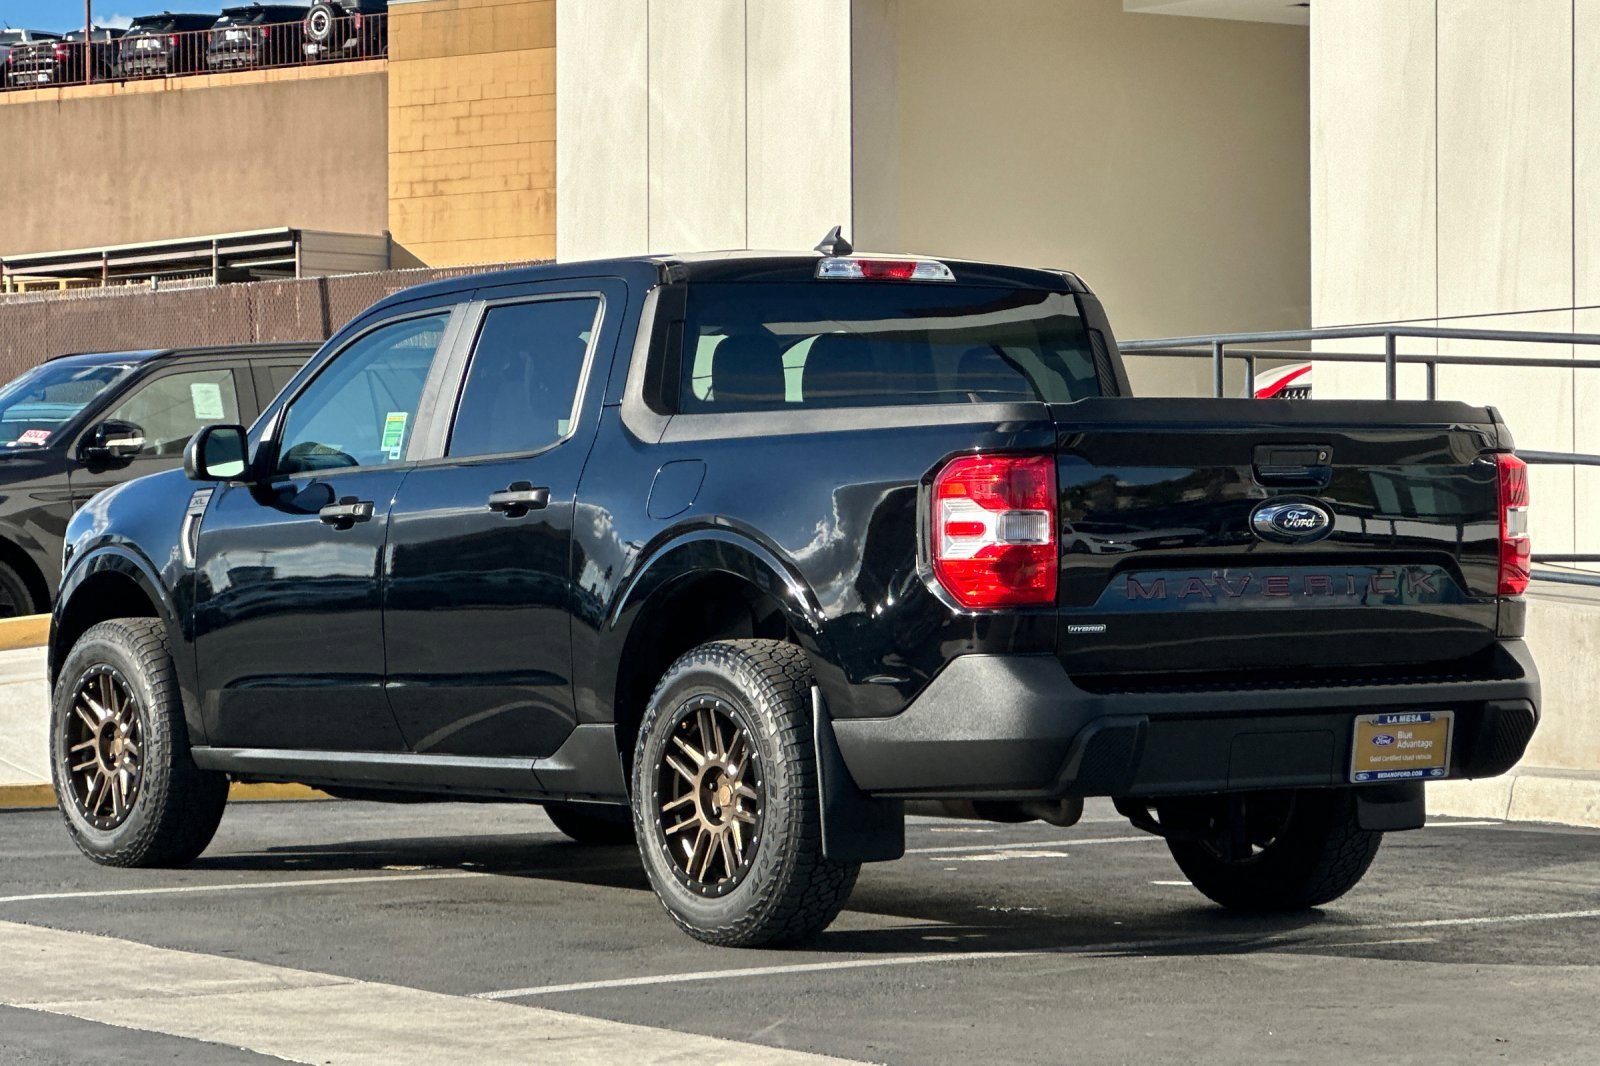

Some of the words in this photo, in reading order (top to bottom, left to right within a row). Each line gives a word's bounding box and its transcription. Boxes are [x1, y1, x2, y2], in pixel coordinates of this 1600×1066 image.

[1283, 510, 1316, 528] Ford
[1126, 573, 1438, 600] MAVERICK
[1387, 715, 1398, 723] LA
[1399, 714, 1422, 722] MESA
[1397, 731, 1413, 739] Blue
[1375, 735, 1392, 745] Ford
[1397, 740, 1433, 749] Advantage
